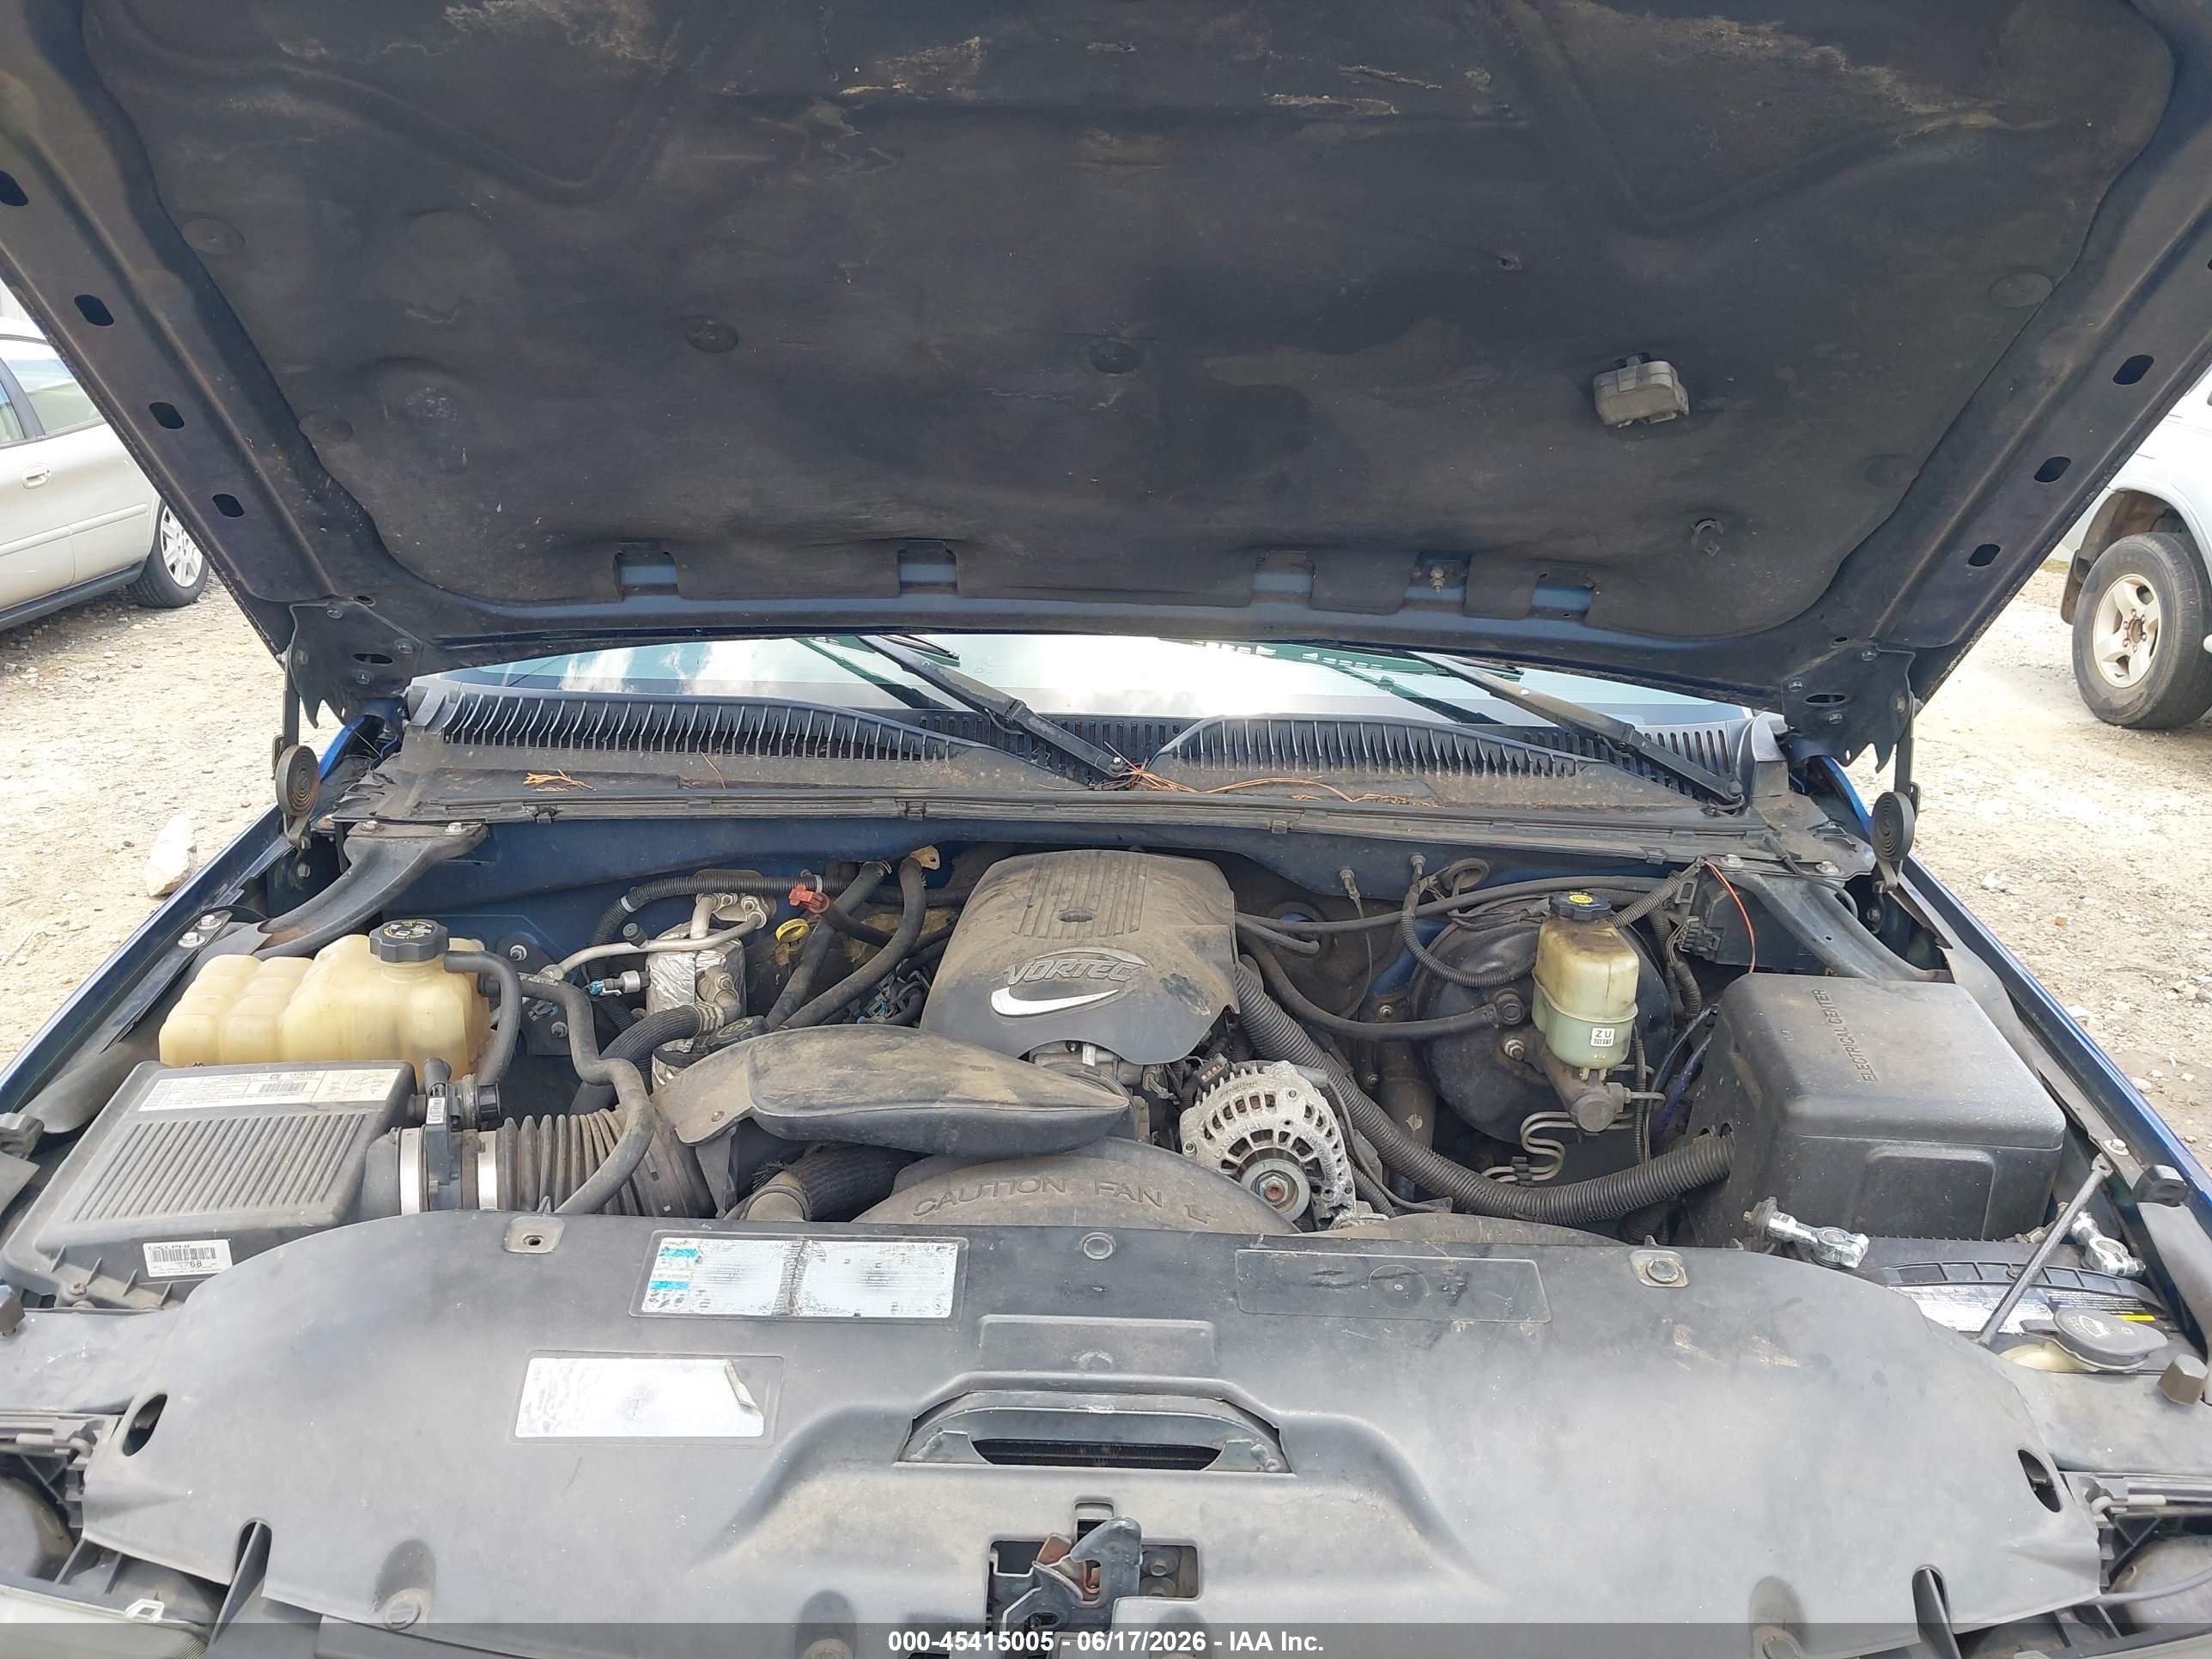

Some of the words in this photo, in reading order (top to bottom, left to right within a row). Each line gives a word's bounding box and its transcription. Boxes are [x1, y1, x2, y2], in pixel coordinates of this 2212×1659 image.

[1003, 959, 1141, 986] VORTEC
[1812, 989, 1843, 1024] CENTER
[1833, 1027, 1877, 1082] ELECTRICAL
[912, 1176, 1066, 1217] CAUTION
[1094, 1177, 1163, 1209] FAN
